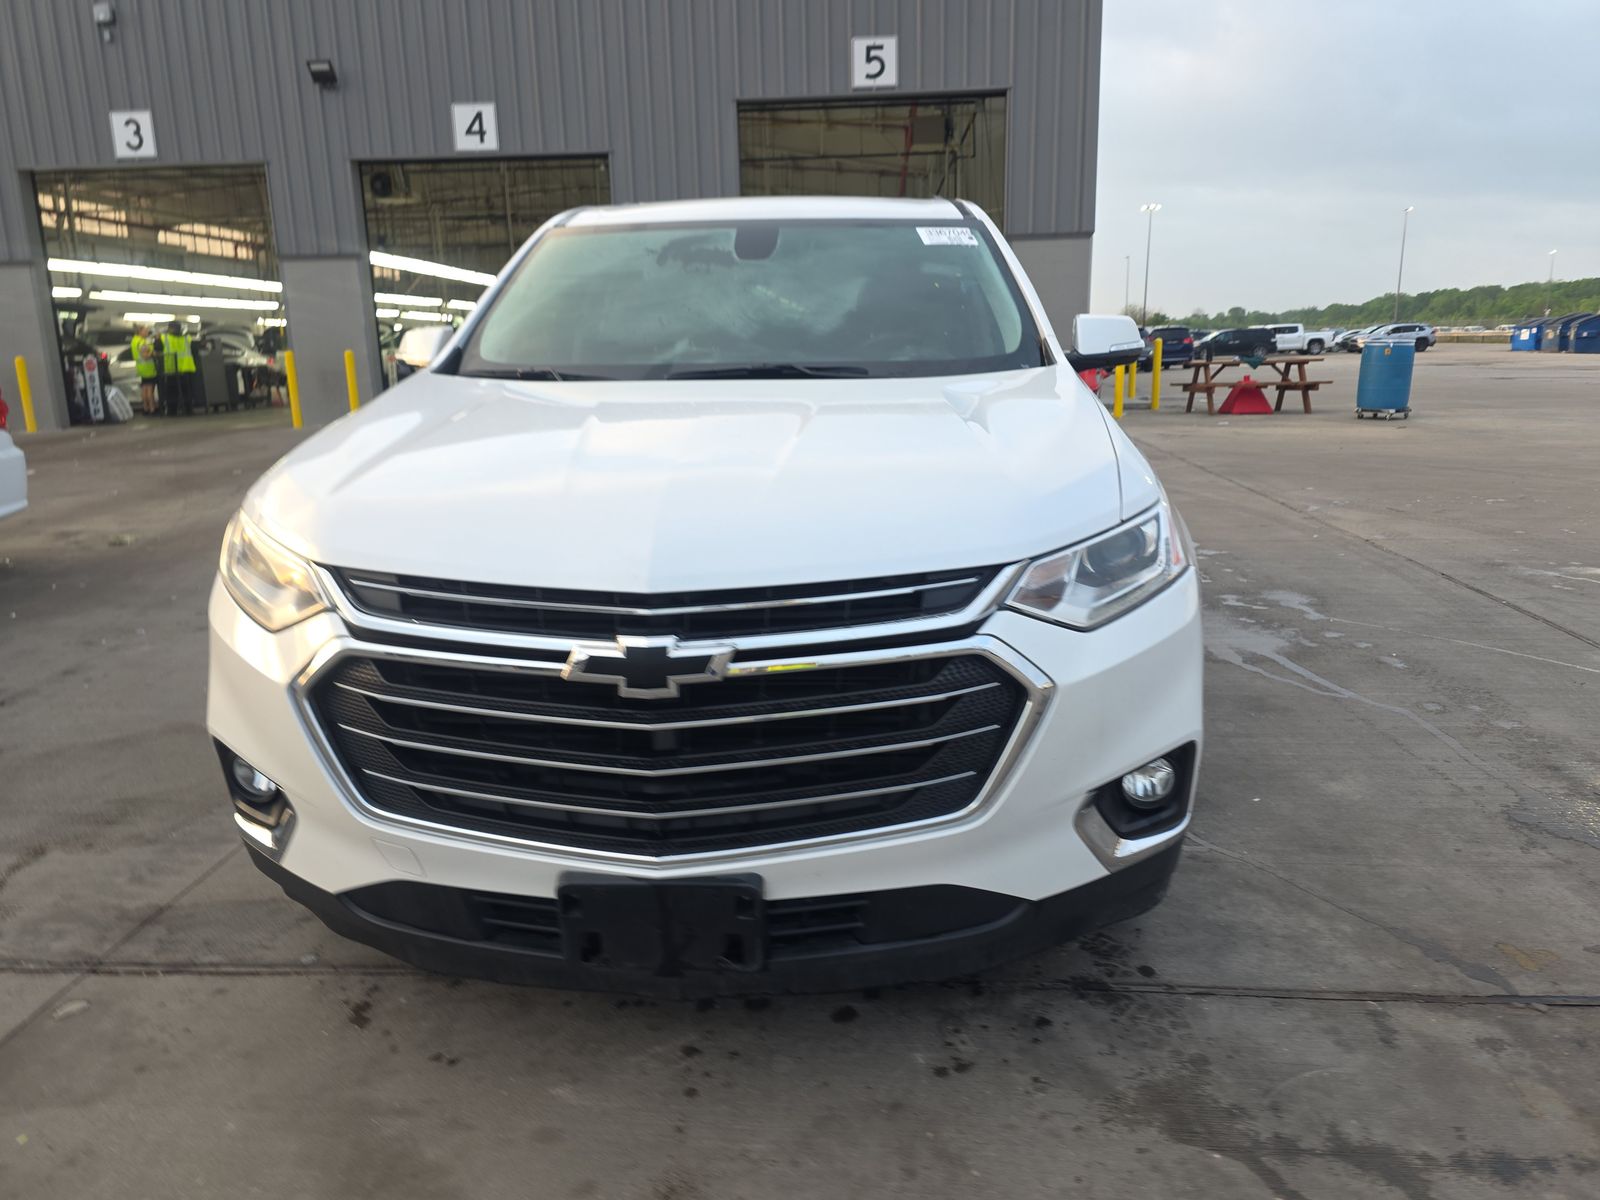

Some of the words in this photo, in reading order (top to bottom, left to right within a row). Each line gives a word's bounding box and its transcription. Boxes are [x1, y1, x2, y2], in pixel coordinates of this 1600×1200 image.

[865, 44, 886, 80] 5
[124, 118, 144, 151] 3
[465, 110, 487, 144] 4
